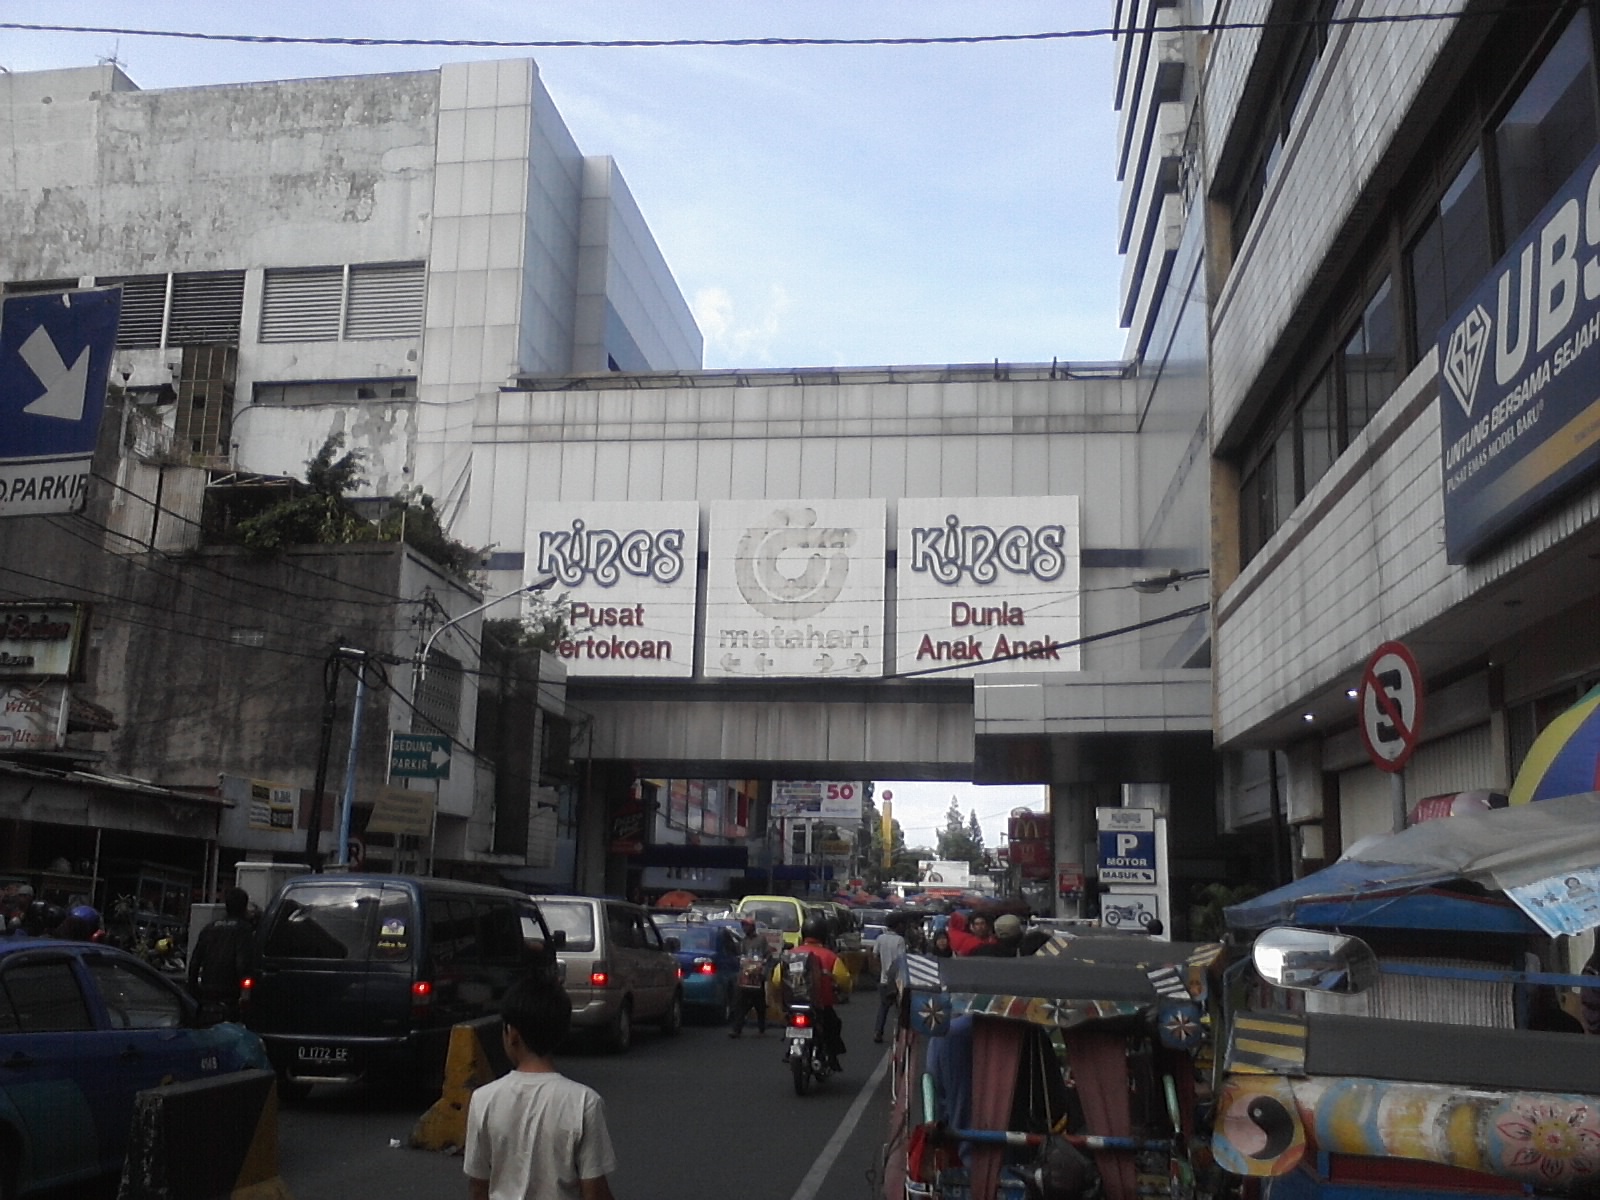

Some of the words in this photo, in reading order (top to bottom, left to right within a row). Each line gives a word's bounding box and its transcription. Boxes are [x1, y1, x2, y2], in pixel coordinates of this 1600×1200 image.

[1447, 414, 1490, 470] UNTUNG
[1491, 359, 1550, 431] BERSAMA
[1554, 311, 1600, 376] SEJAH
[1489, 425, 1515, 457] MODEL
[570, 602, 645, 627] Pusat
[951, 601, 1025, 627] Dunia
[555, 635, 672, 661] ertokoan
[719, 624, 870, 649] matahari
[916, 633, 984, 661] Anak
[991, 633, 1061, 661] Anak
[392, 740, 433, 753] GEDUNG
[391, 757, 429, 770] PARKIR
[1116, 833, 1138, 857] P
[1106, 857, 1148, 867] MOTOR
[1102, 871, 1139, 879] MASUK
